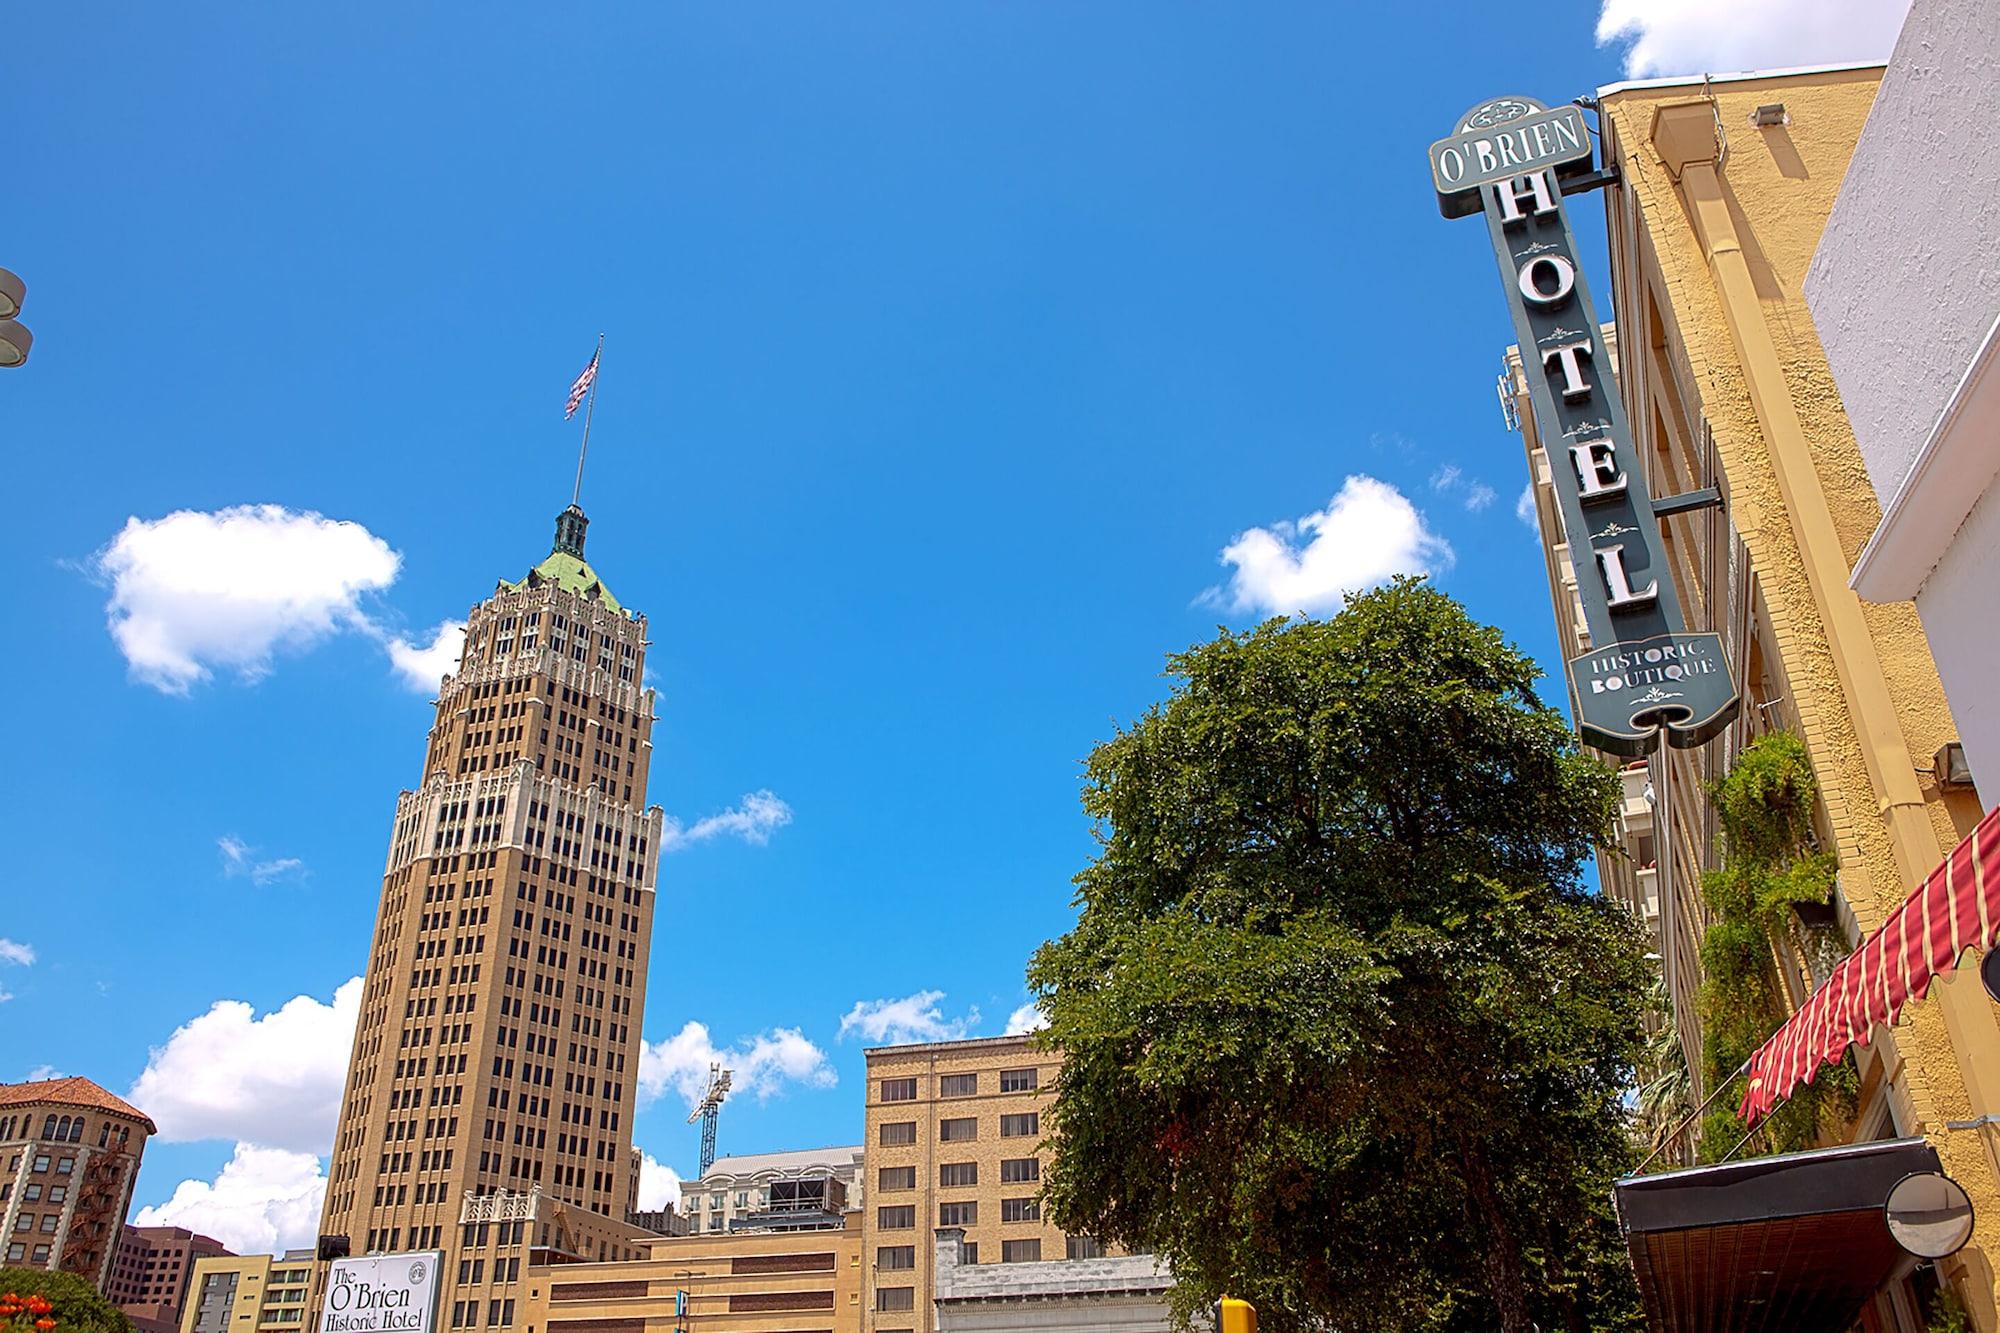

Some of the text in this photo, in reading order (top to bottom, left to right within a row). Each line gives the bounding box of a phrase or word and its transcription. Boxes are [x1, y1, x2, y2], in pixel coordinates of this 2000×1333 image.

[1439, 114, 1580, 183] O'BRIEN
[1493, 169, 1659, 608] HOTEL
[1591, 639, 1706, 674] HISTORIC
[1590, 657, 1717, 695] BOUTIQUE
[334, 1267, 357, 1285] The
[330, 1282, 410, 1311] O'Brien
[325, 1307, 423, 1332] Historic Hotel
